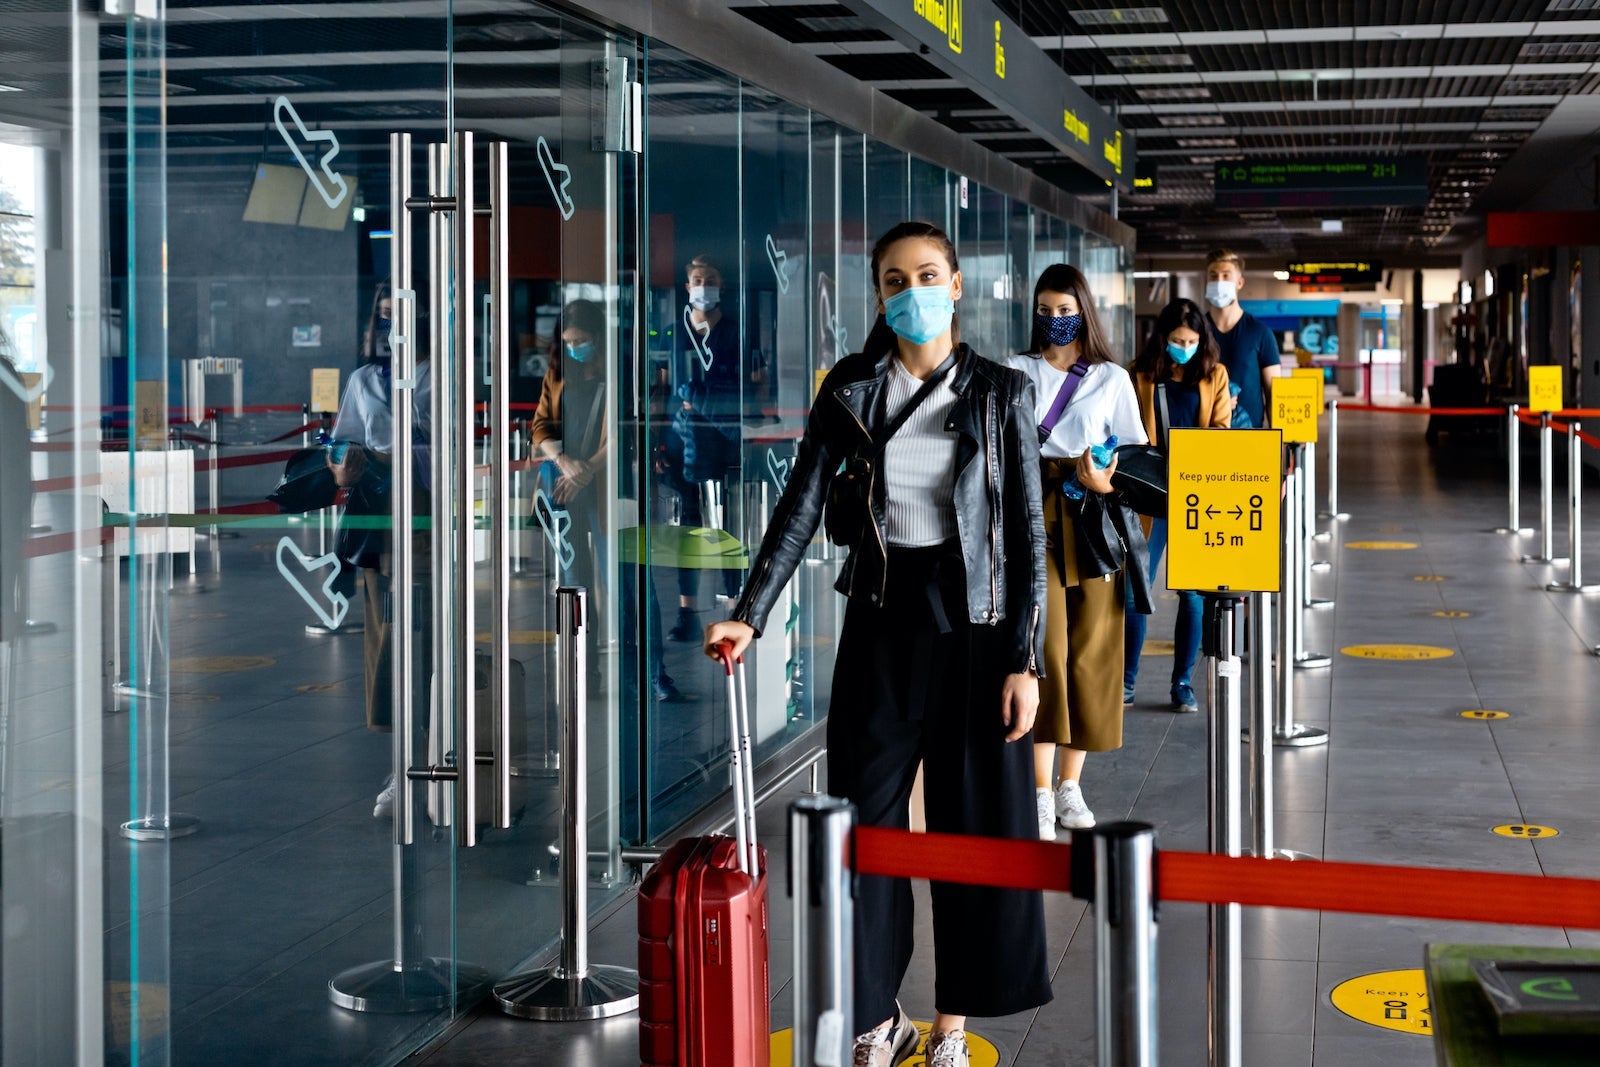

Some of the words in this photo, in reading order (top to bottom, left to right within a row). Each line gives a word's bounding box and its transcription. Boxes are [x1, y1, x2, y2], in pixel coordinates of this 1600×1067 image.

[1179, 472, 1203, 483] Keep
[1205, 474, 1228, 483] your
[1230, 472, 1270, 483] distance
[1204, 531, 1225, 547] 1,5
[1230, 535, 1244, 546] m
[1366, 989, 1409, 997] Keep
